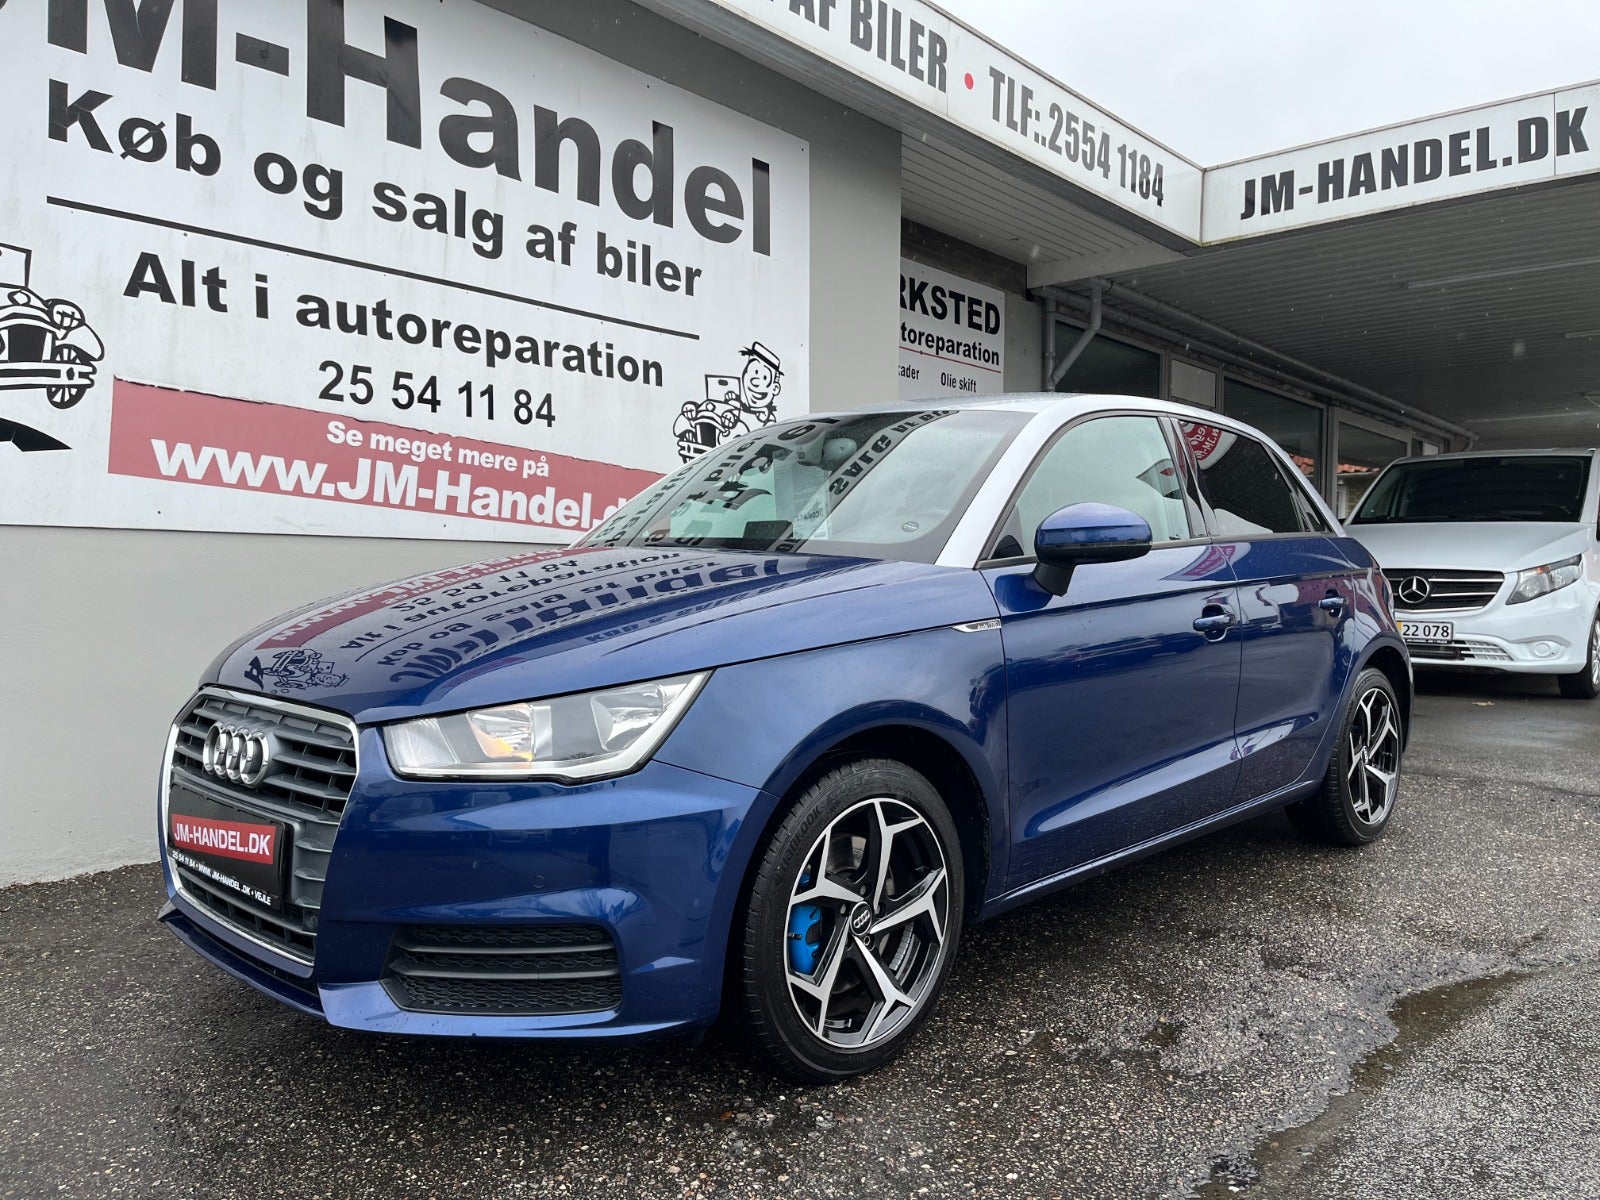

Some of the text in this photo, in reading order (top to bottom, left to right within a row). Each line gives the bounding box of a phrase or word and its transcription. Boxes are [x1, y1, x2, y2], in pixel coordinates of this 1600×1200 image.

[0, 0, 771, 257] M-Handel
[789, 0, 836, 31] F
[850, 0, 948, 93] BILER
[1117, 143, 1164, 207] 1184
[48, 78, 703, 297] Køb og salg af biler
[1240, 106, 1590, 221] JM-HANDEL.DK
[123, 251, 663, 387] Alt i autoreparation
[318, 360, 556, 428] 25 54 11 84
[940, 371, 977, 393] Olie skift
[326, 420, 550, 480] Se meget mere på
[1402, 624, 1450, 638] 22 078
[174, 822, 271, 856] JM-HANDEL.DK
